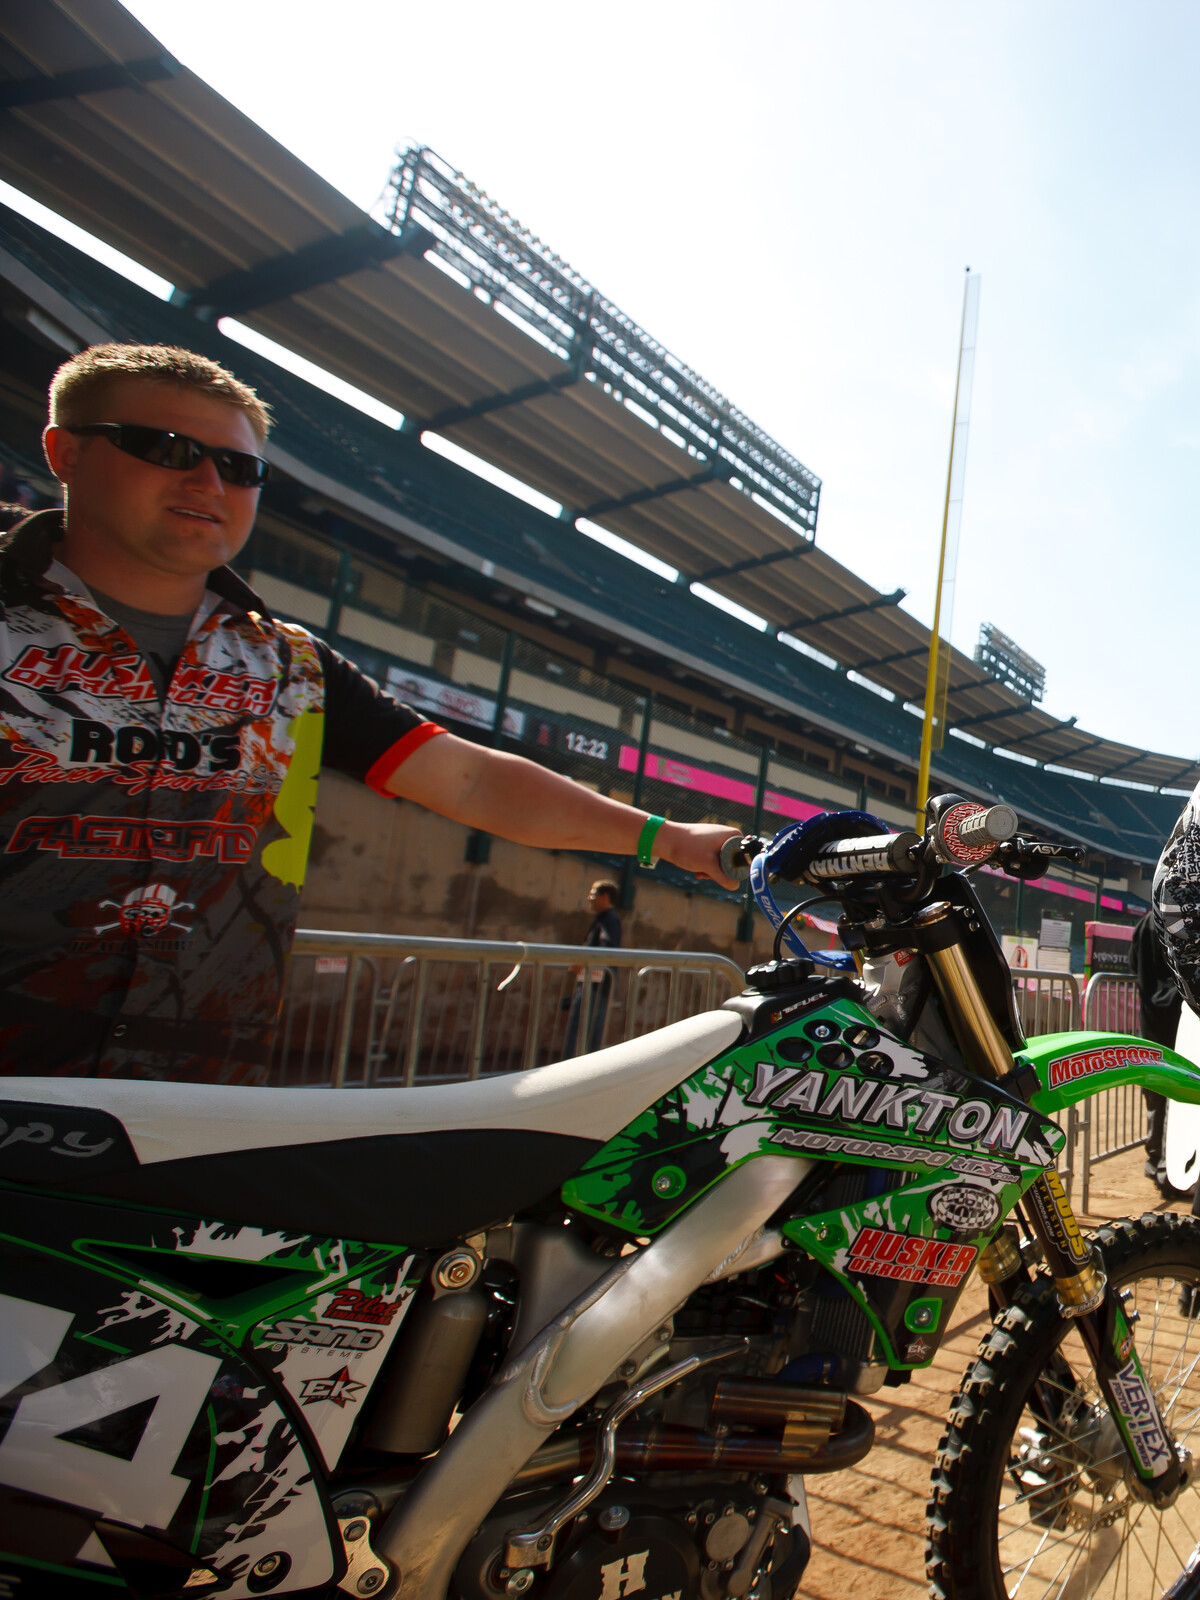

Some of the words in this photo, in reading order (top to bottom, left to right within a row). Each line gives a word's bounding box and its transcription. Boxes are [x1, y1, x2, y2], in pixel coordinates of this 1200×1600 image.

[70, 718, 241, 772] ROD'S
[564, 731, 608, 760] 12:22
[0, 745, 119, 785] Power
[112, 760, 234, 796] Sports
[1032, 844, 1062, 857] ASV
[1093, 951, 1128, 964] MONSTE
[1050, 1046, 1163, 1088] MOTOSPORT
[747, 1062, 1030, 1151] YANKTON
[770, 1127, 1019, 1184] MOTORSPORTS.COM
[1037, 1176, 1068, 1249] SPENSION
[850, 1227, 979, 1275] HUSKER
[847, 1257, 966, 1288] OFFROAD.COM
[261, 1318, 385, 1352] SANO
[321, 1308, 394, 1326] FINANCIAL
[272, 1343, 365, 1360] SYSTEMS
[299, 1378, 368, 1403] EK
[1112, 1382, 1132, 1416] PISTON
[1133, 1435, 1152, 1468] POWER
[1118, 1363, 1171, 1464] VERTEX
